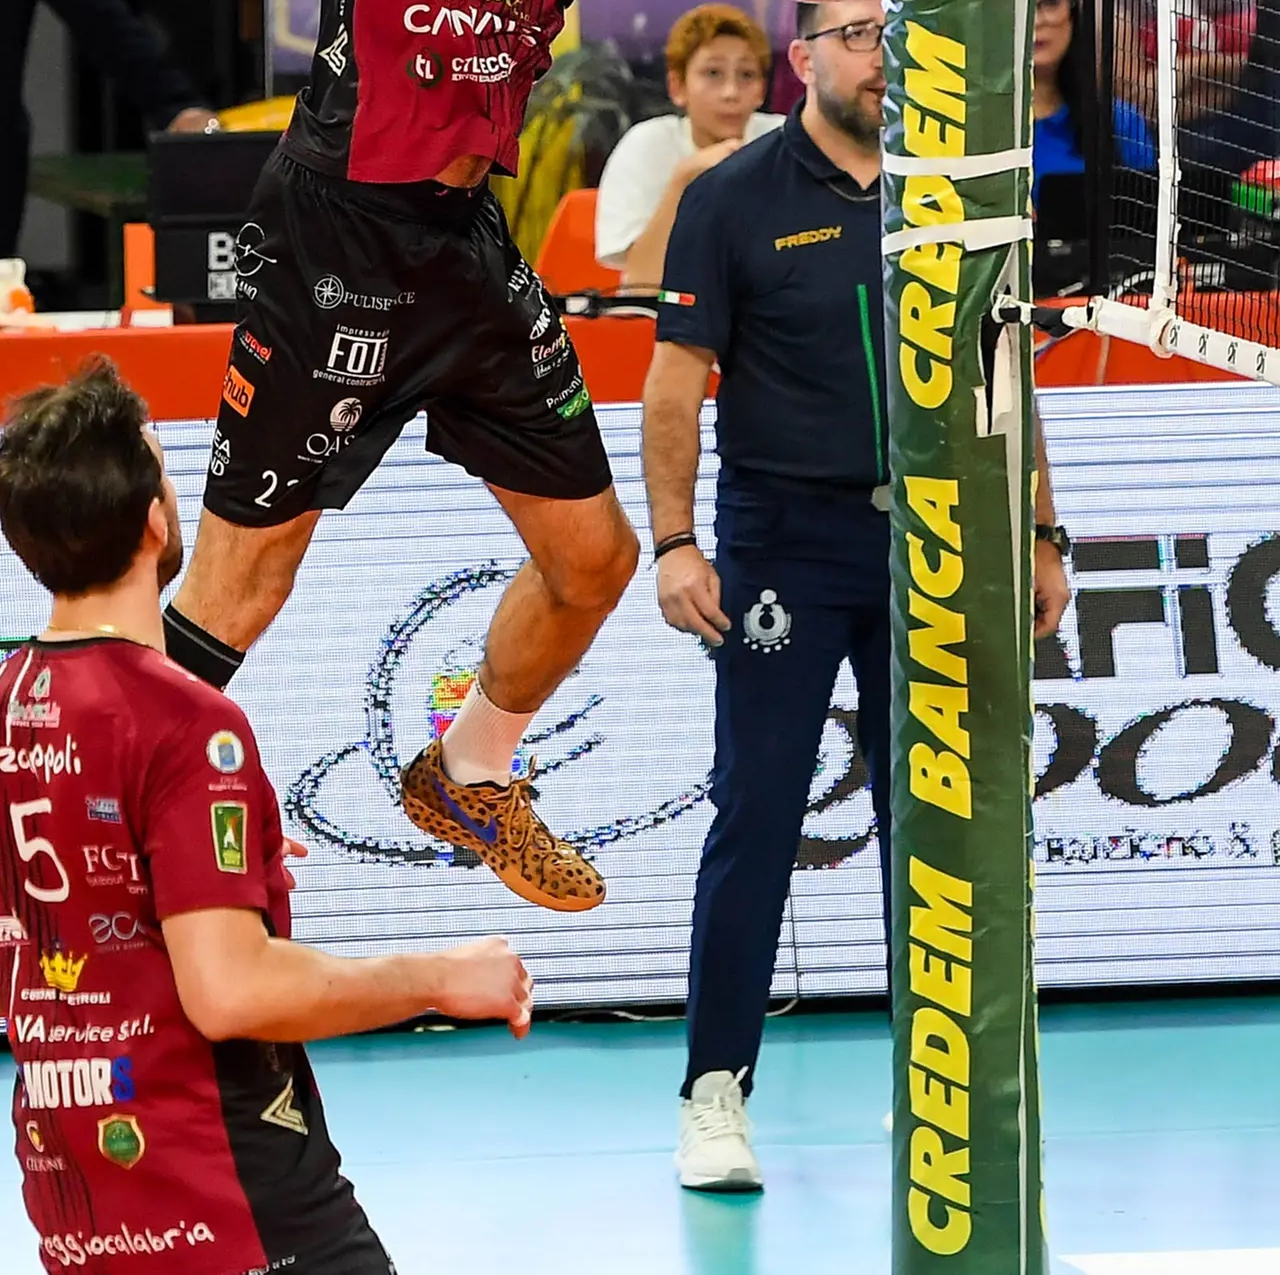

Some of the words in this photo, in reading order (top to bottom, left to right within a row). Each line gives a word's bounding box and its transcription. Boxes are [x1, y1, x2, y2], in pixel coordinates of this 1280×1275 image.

[774, 225, 844, 252] FREDDY
[904, 475, 974, 821] BANCA
[9, 797, 70, 903] 5
[907, 855, 974, 1258] CREDEM
